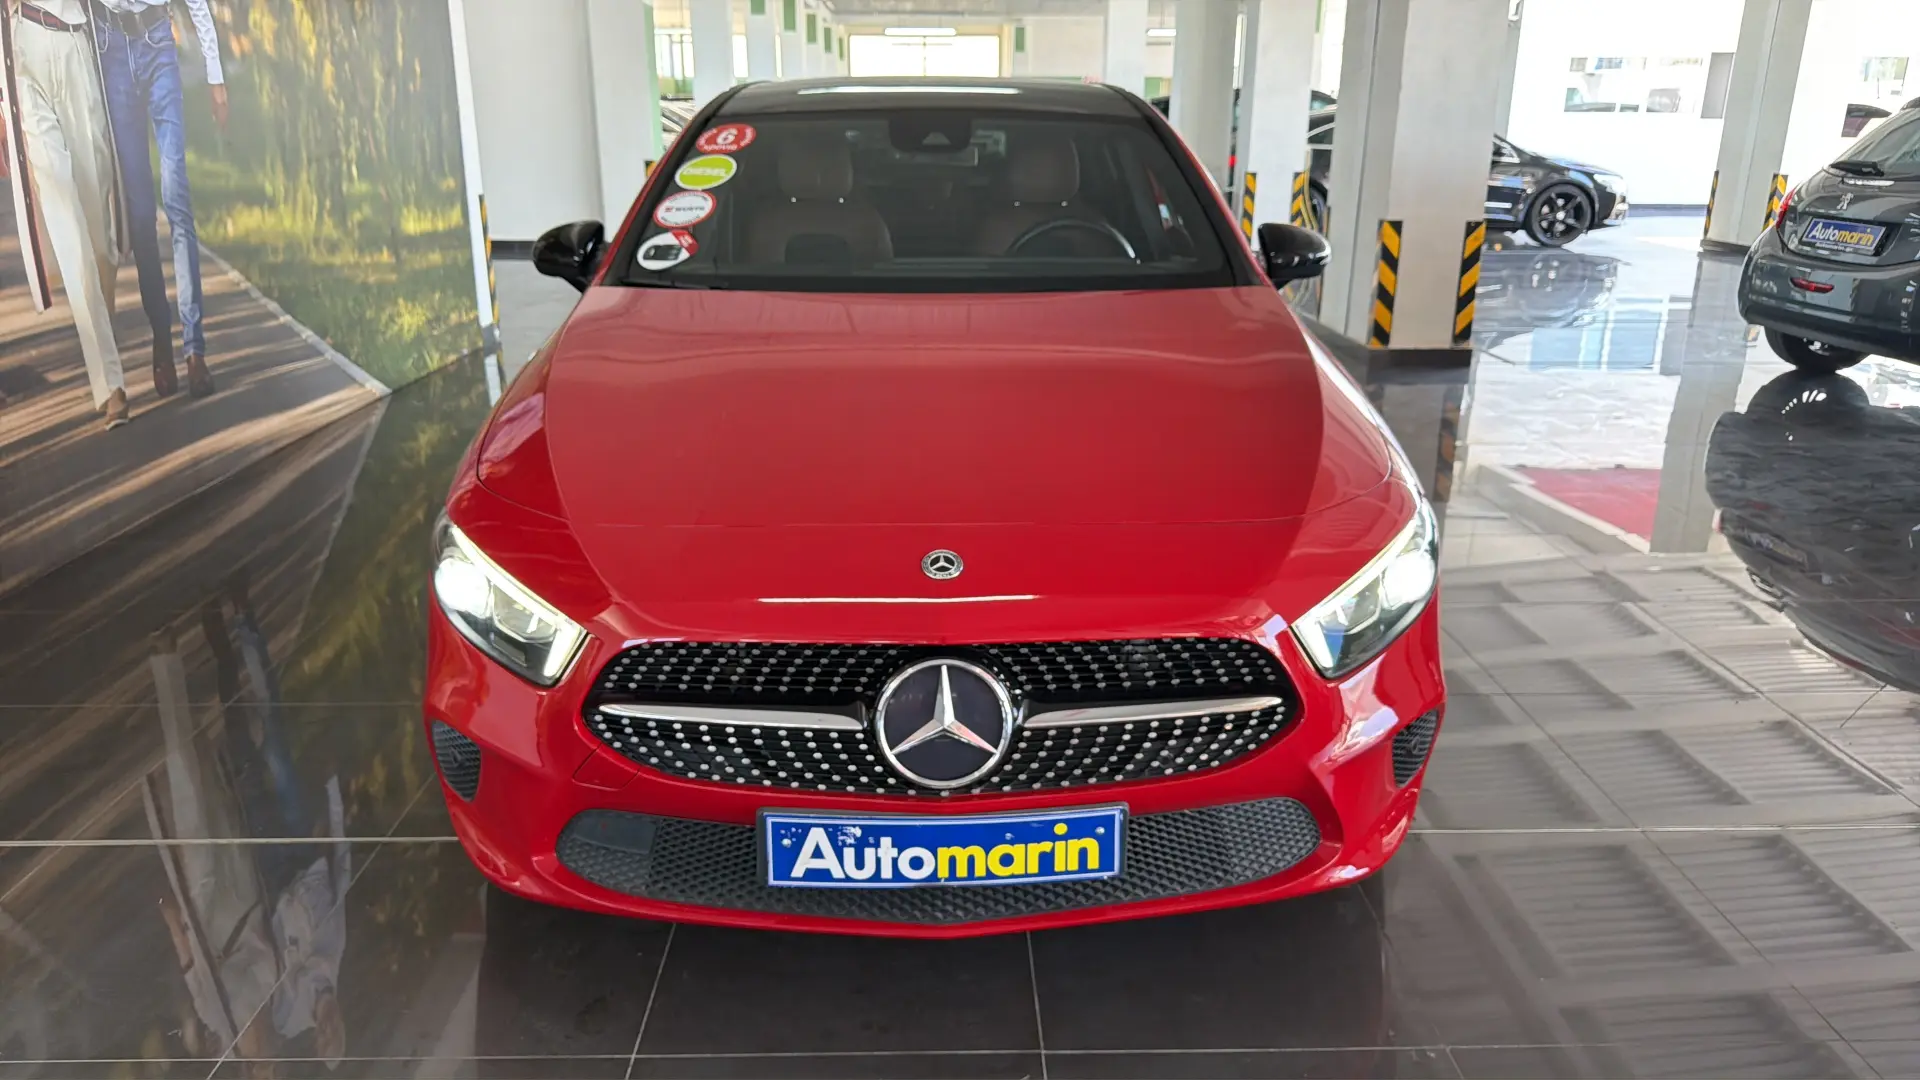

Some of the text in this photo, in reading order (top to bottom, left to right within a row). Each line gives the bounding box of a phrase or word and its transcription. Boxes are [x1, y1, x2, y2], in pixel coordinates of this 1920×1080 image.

[717, 128, 738, 145] 6
[1808, 222, 1874, 246] Automarin
[790, 823, 1100, 880] Automarin
